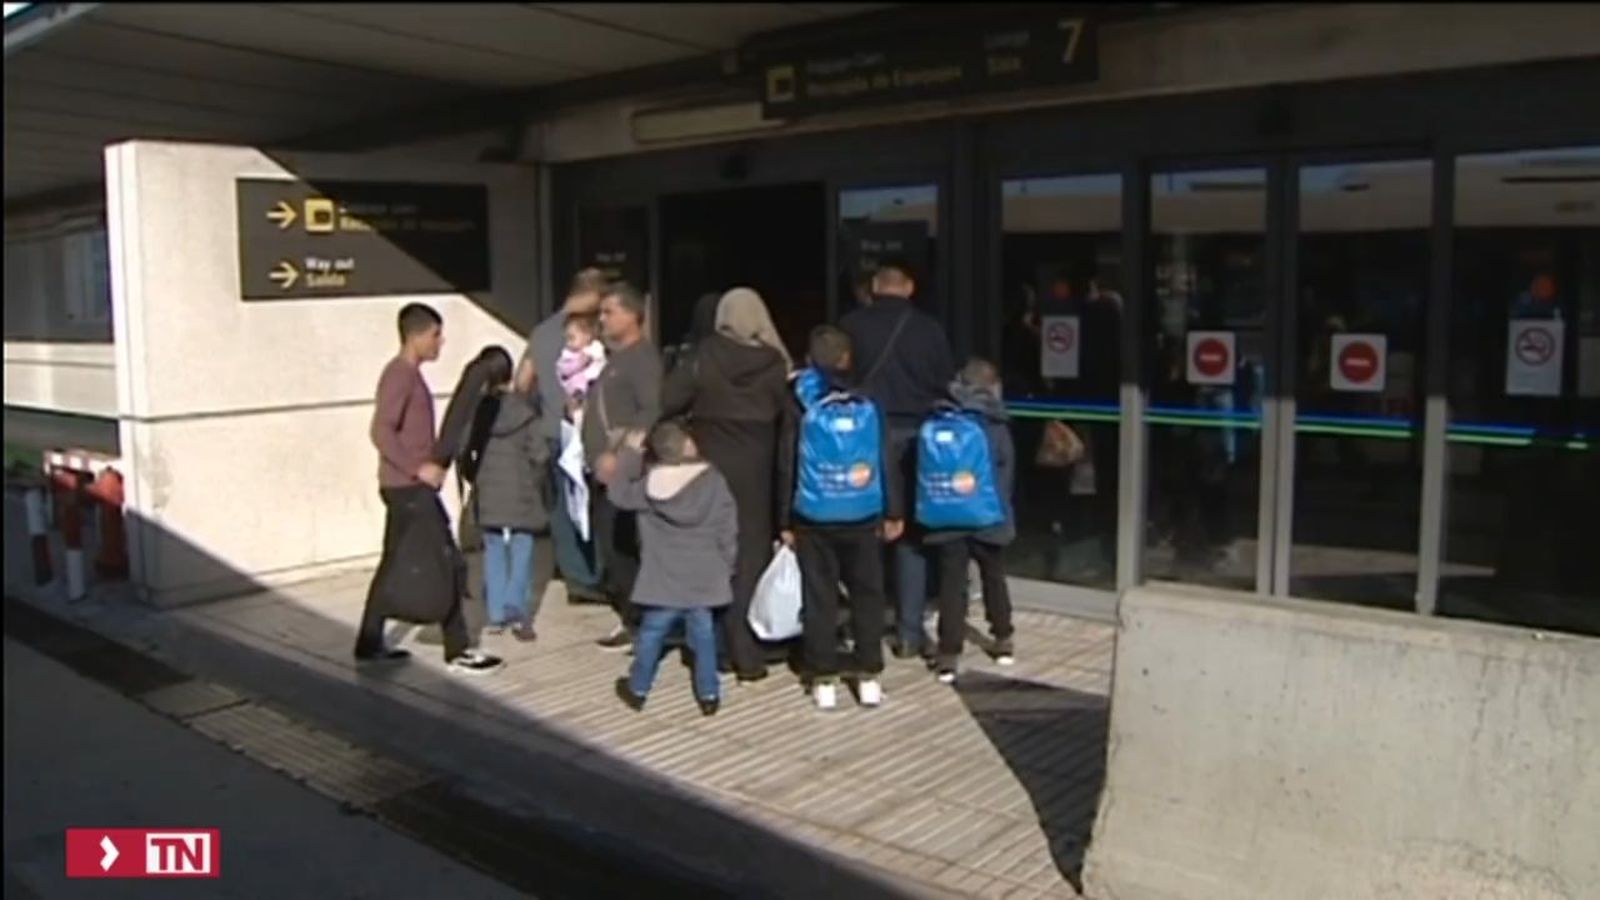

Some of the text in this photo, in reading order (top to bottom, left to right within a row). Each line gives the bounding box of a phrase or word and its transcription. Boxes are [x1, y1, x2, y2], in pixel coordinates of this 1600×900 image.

[1057, 19, 1085, 64] 7
[305, 257, 355, 273] Way out
